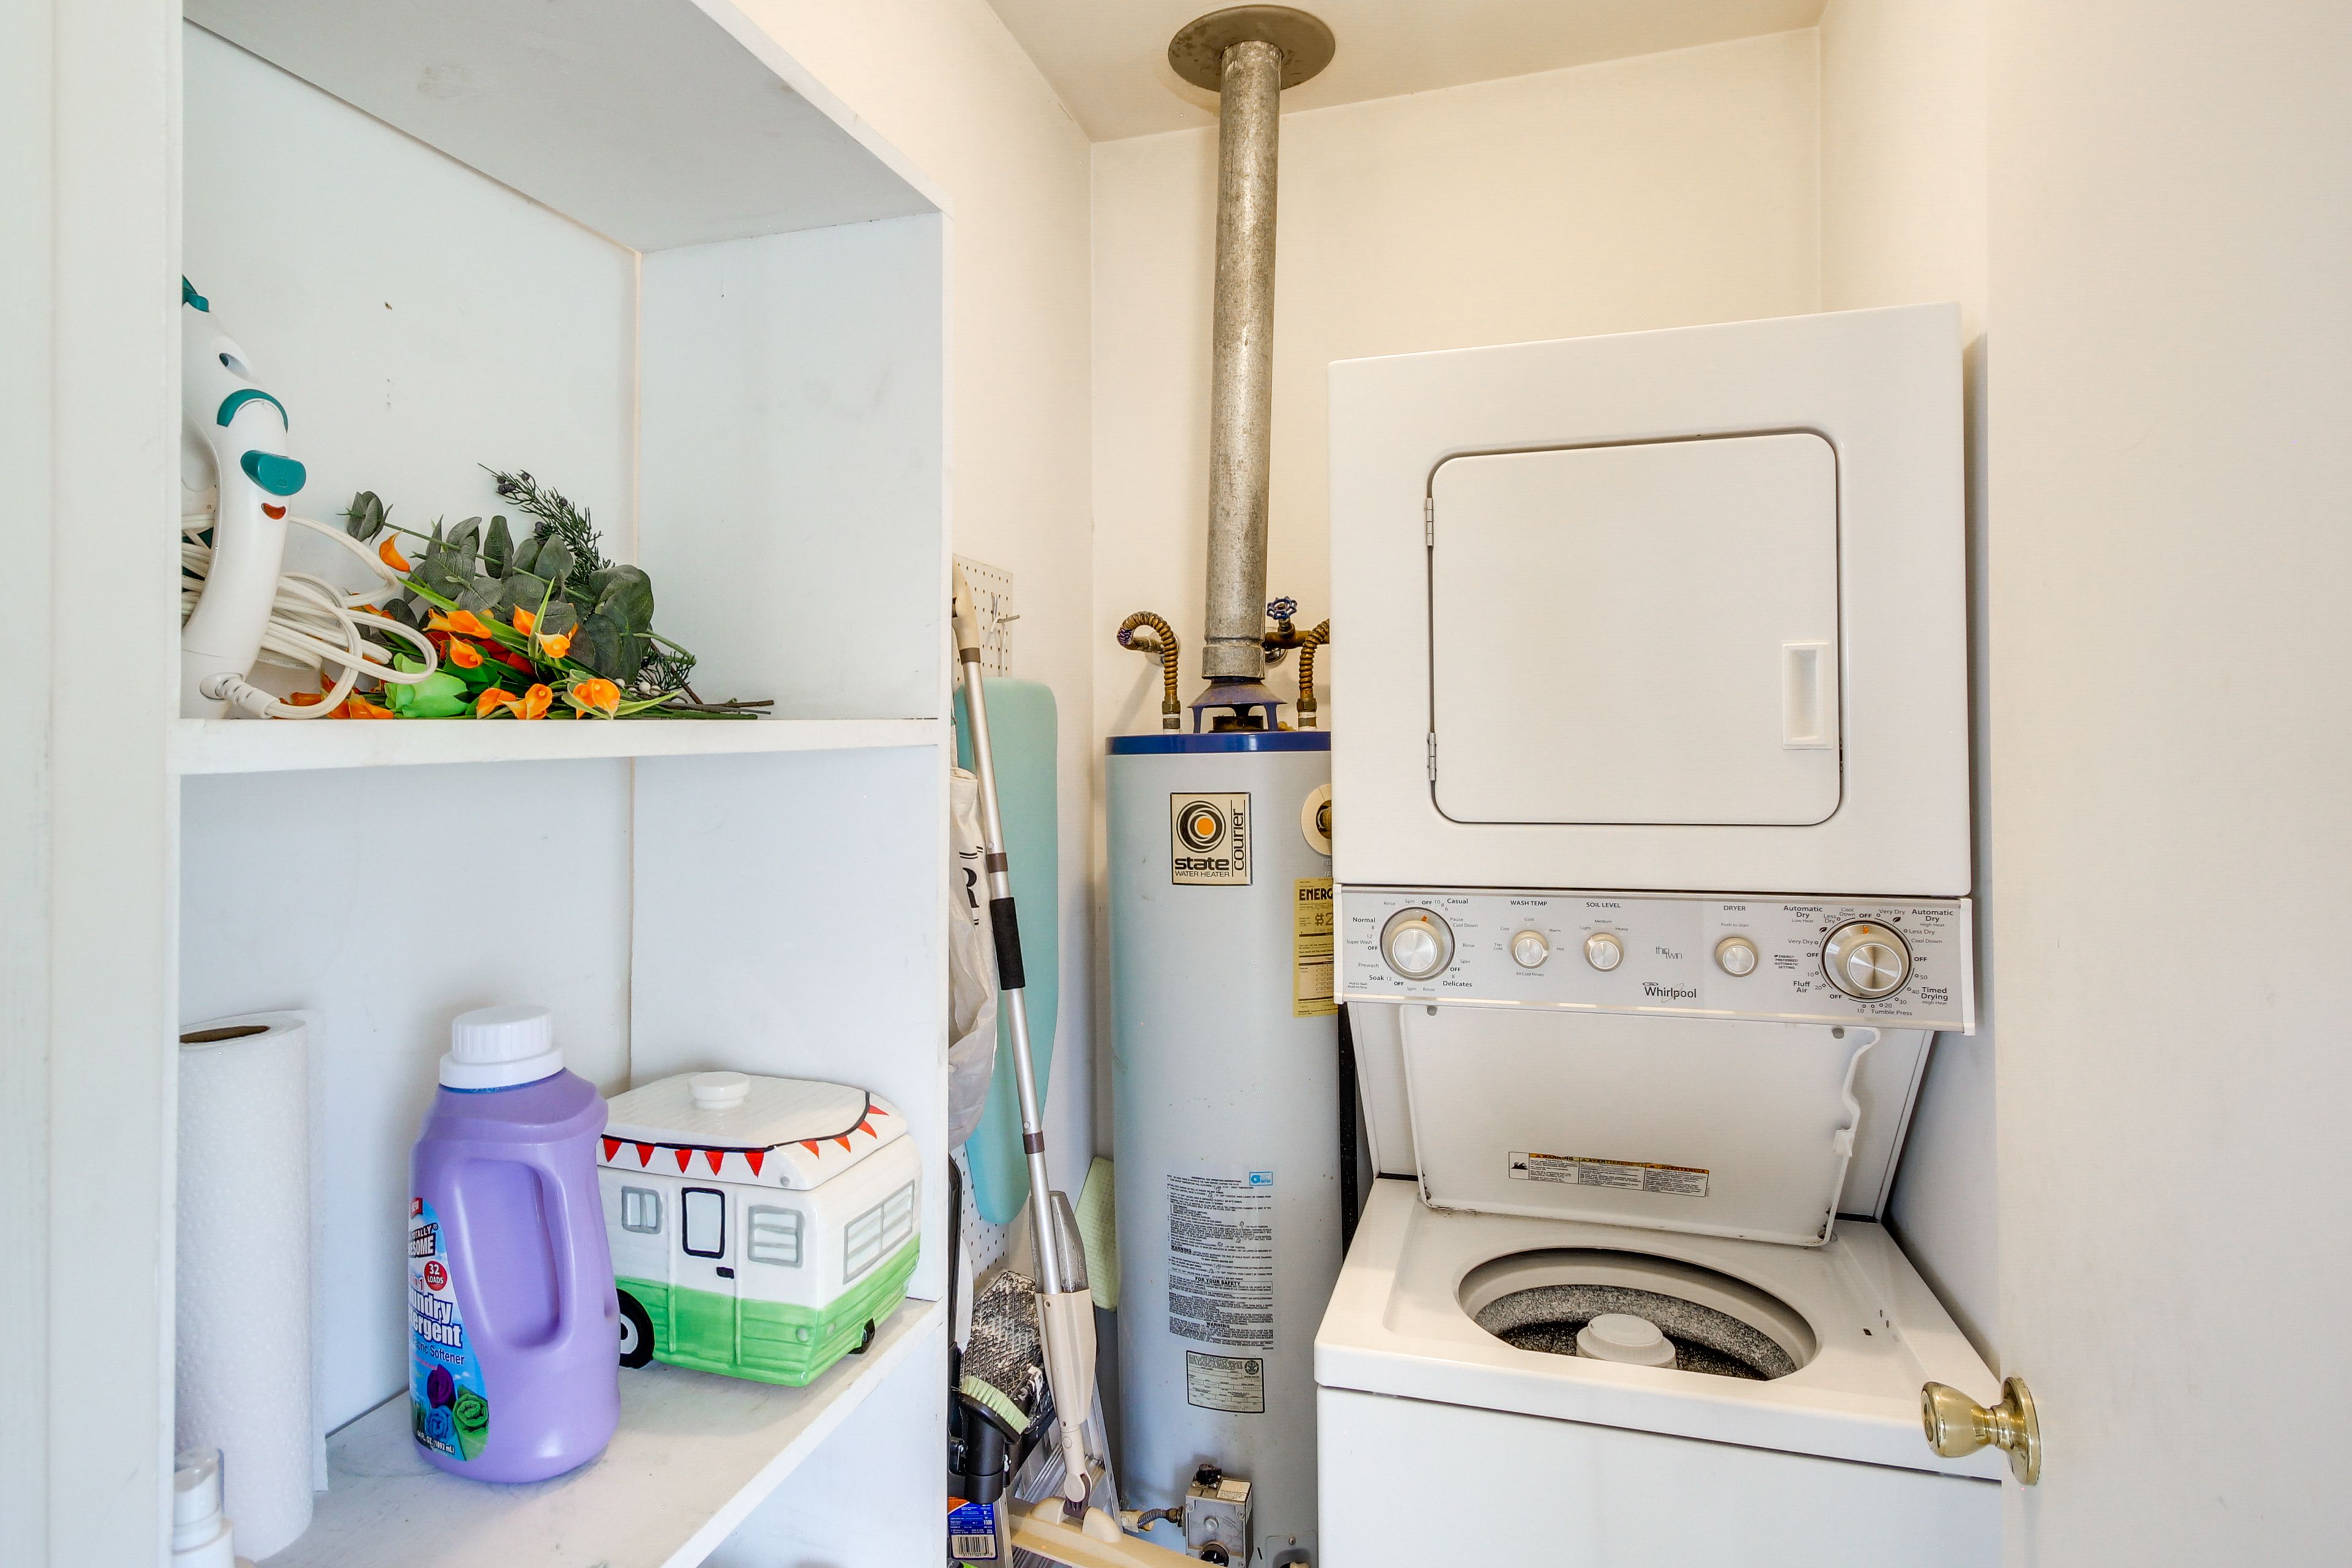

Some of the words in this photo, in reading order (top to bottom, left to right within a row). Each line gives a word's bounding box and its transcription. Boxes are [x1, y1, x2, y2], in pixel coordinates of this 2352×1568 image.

[1233, 809, 1245, 870] courier
[1175, 857, 1229, 870] state
[1645, 986, 1697, 1000] Whirlpool
[429, 1263, 440, 1275] 32
[427, 1275, 443, 1284] LOADS
[430, 1345, 465, 1365] Softener
